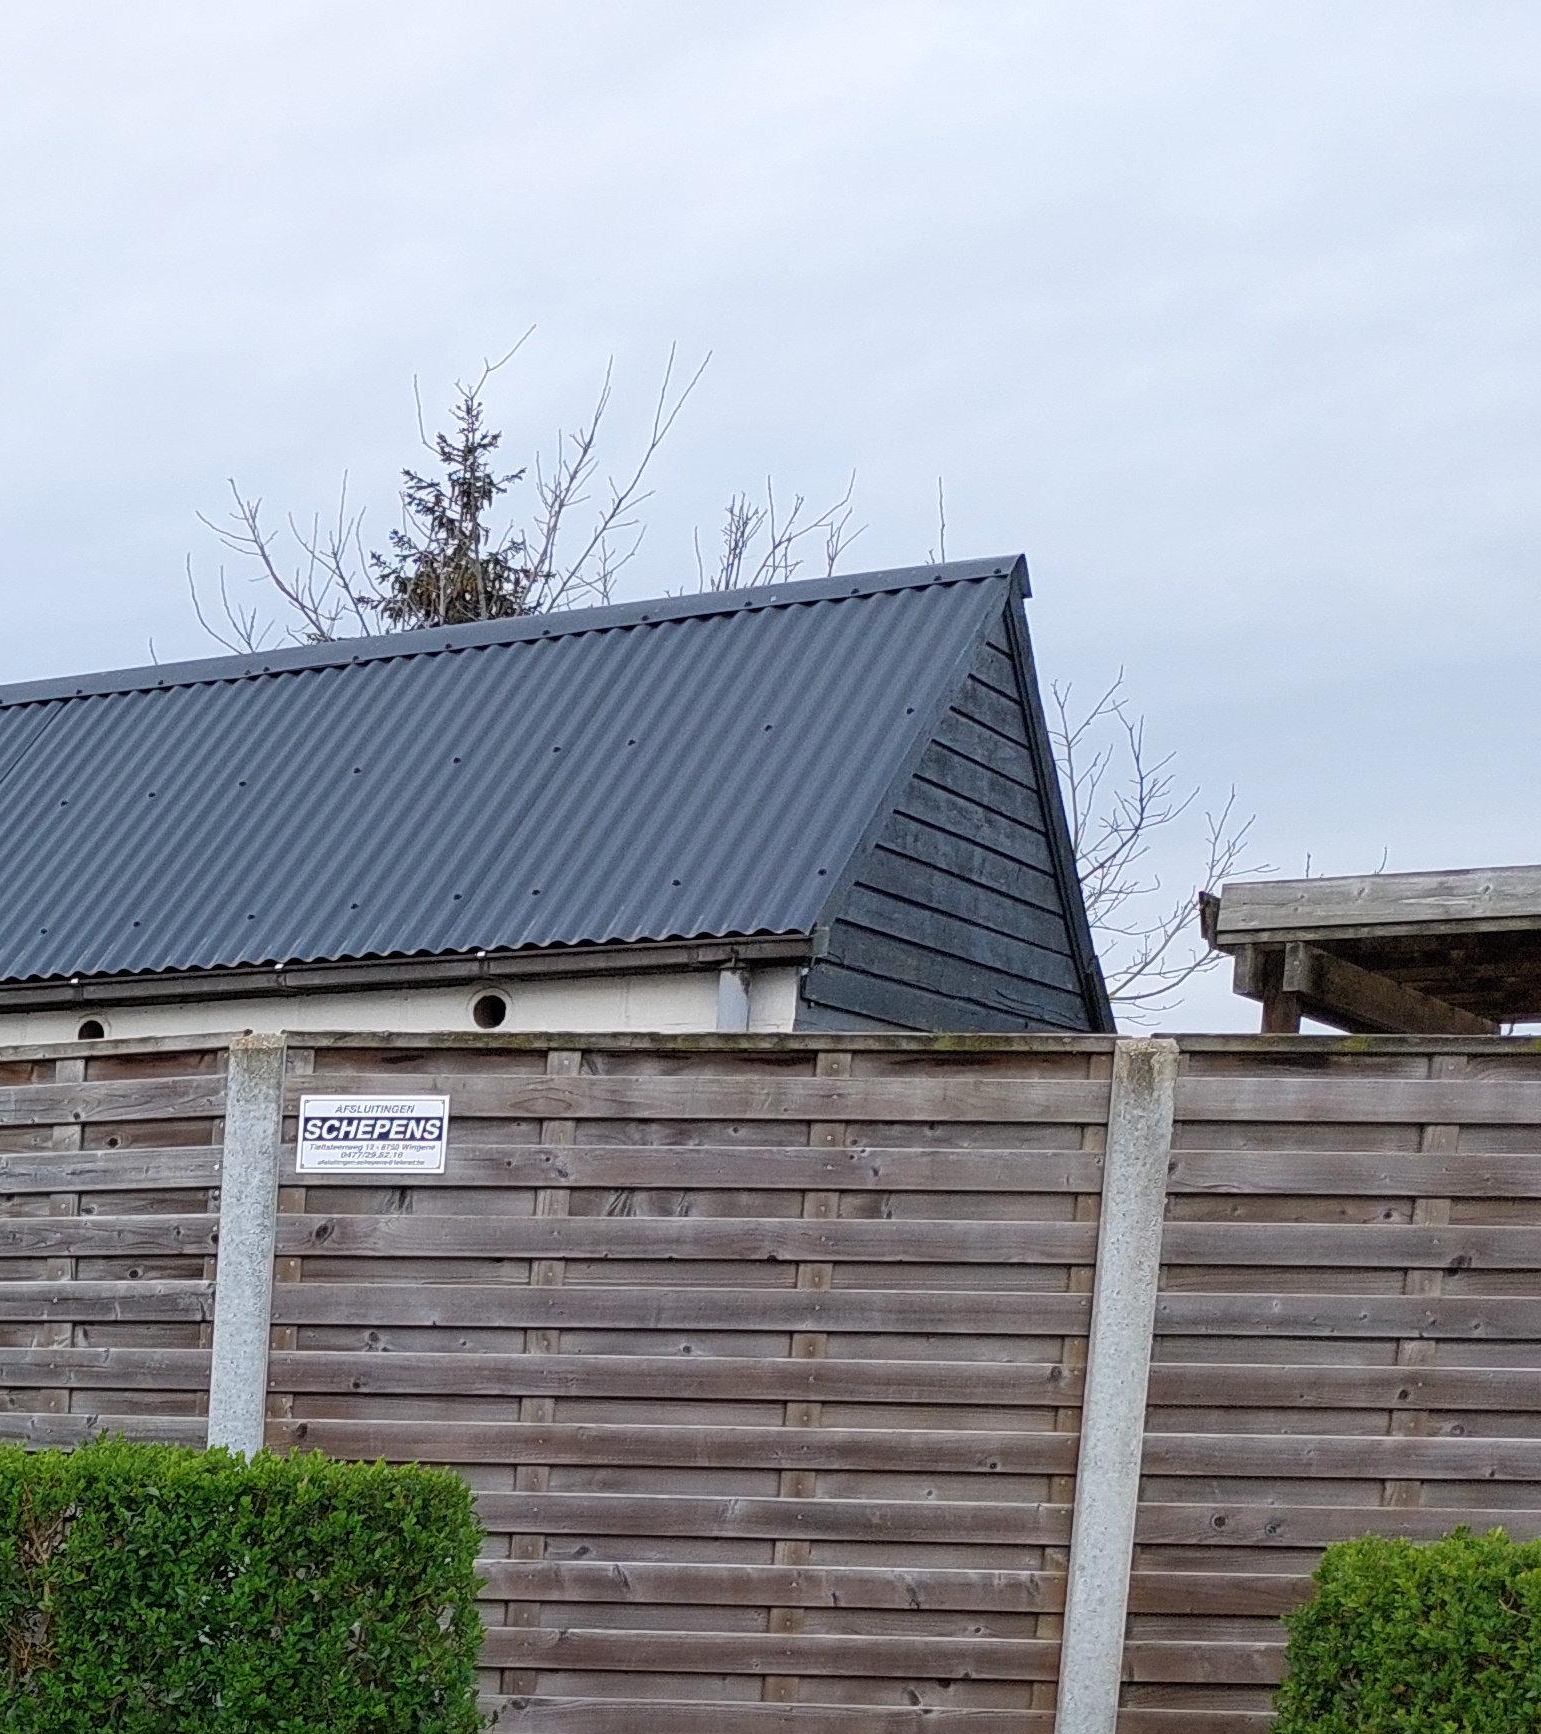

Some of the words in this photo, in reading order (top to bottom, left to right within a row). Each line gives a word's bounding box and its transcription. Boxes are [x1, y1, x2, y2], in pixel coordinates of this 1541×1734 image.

[335, 1104, 415, 1114] AFSLUITINGEN
[304, 1119, 441, 1140] SCHEPENS
[402, 1143, 436, 1152] Wingene
